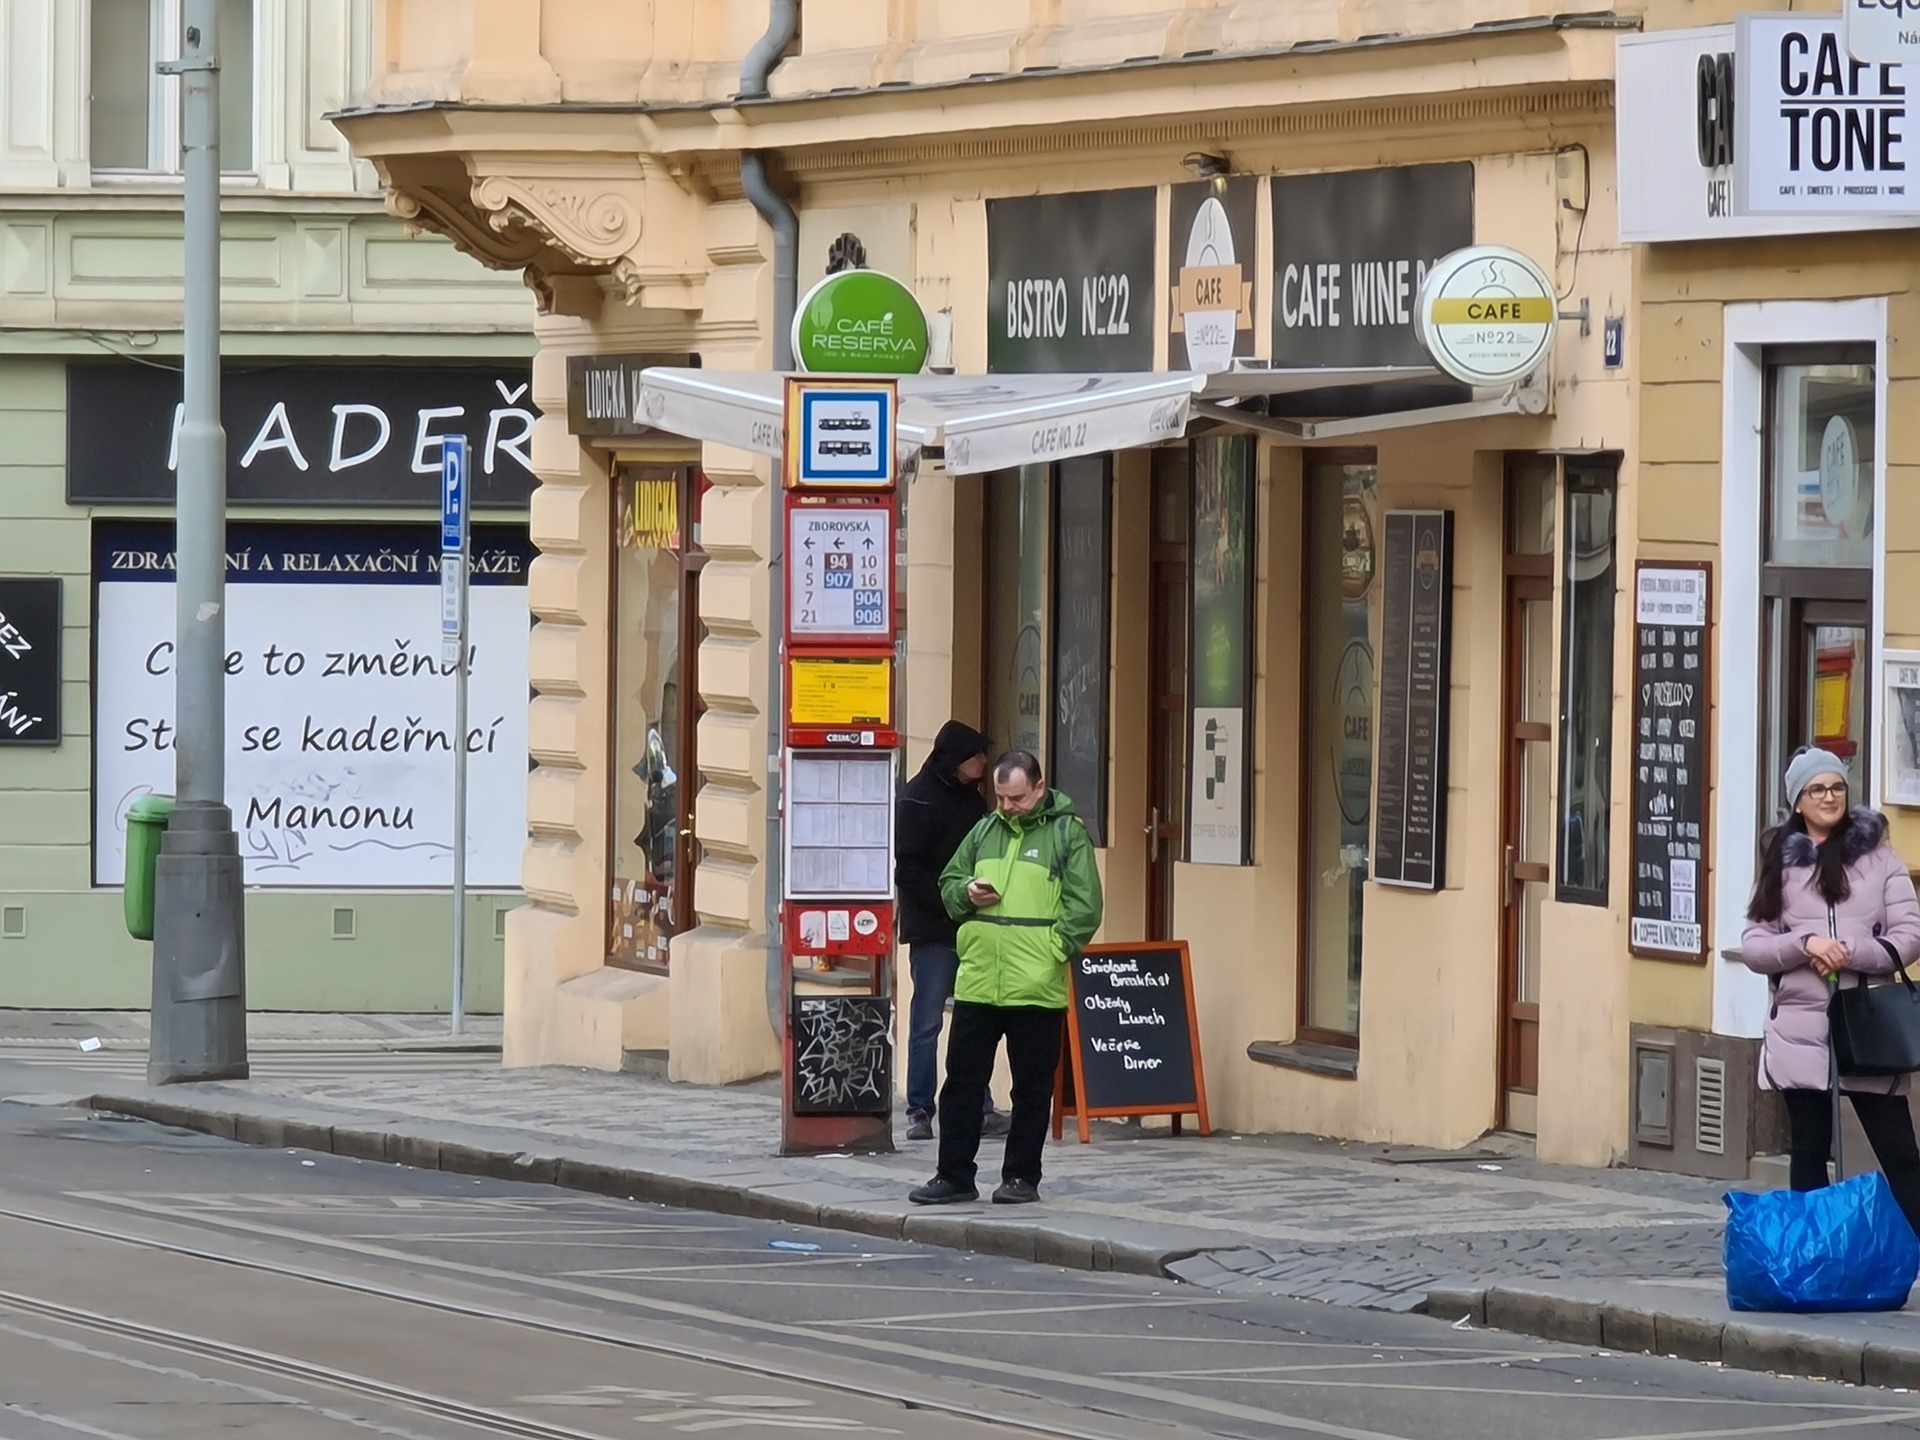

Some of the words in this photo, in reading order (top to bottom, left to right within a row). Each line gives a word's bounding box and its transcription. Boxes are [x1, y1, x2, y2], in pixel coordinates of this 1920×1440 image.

[1780, 108, 1905, 171] TONE
[1779, 186, 1796, 195] CAFE
[1807, 186, 1833, 195] SWEETS
[1843, 186, 1878, 195] PROSECCO
[1195, 277, 1222, 305] CAFE
[1281, 263, 1341, 329] CAFE
[1351, 260, 1410, 326] WINE
[1007, 278, 1068, 339] BISTRO
[1467, 303, 1521, 320] CAFE
[836, 312, 893, 334] CAFÉ
[812, 334, 917, 352] RESERVA
[1606, 330, 1617, 357] 22
[585, 363, 627, 418] LIDICKÁ
[168, 379, 534, 475] ADEŘ
[1074, 422, 1088, 448] 22
[634, 472, 678, 531] LIDICKÁ
[808, 519, 871, 532] ZBOROVSKÁ
[112, 549, 250, 570] ZDRANÍ
[259, 552, 273, 571] A
[282, 548, 418, 573] RELAXAČNÍ
[427, 548, 521, 574] MSÁŽE
[804, 555, 814, 568] 4
[830, 555, 848, 568] 94
[861, 556, 877, 568] 10
[805, 573, 814, 586] 5
[825, 573, 851, 587] 907
[861, 574, 877, 587] 16
[805, 591, 814, 604] 7
[855, 591, 881, 605] 904
[801, 610, 818, 623] 21
[855, 609, 881, 623] 908
[145, 641, 244, 676] Ce
[263, 644, 306, 676] to
[242, 724, 281, 752] se
[301, 715, 504, 753] kadeřncí
[1343, 715, 1369, 741] CAFE
[245, 796, 415, 830] Manonu
[1109, 971, 1171, 988] Breakfast
[1118, 1007, 1166, 1026] Lunch
[1123, 1055, 1163, 1070] Diner
